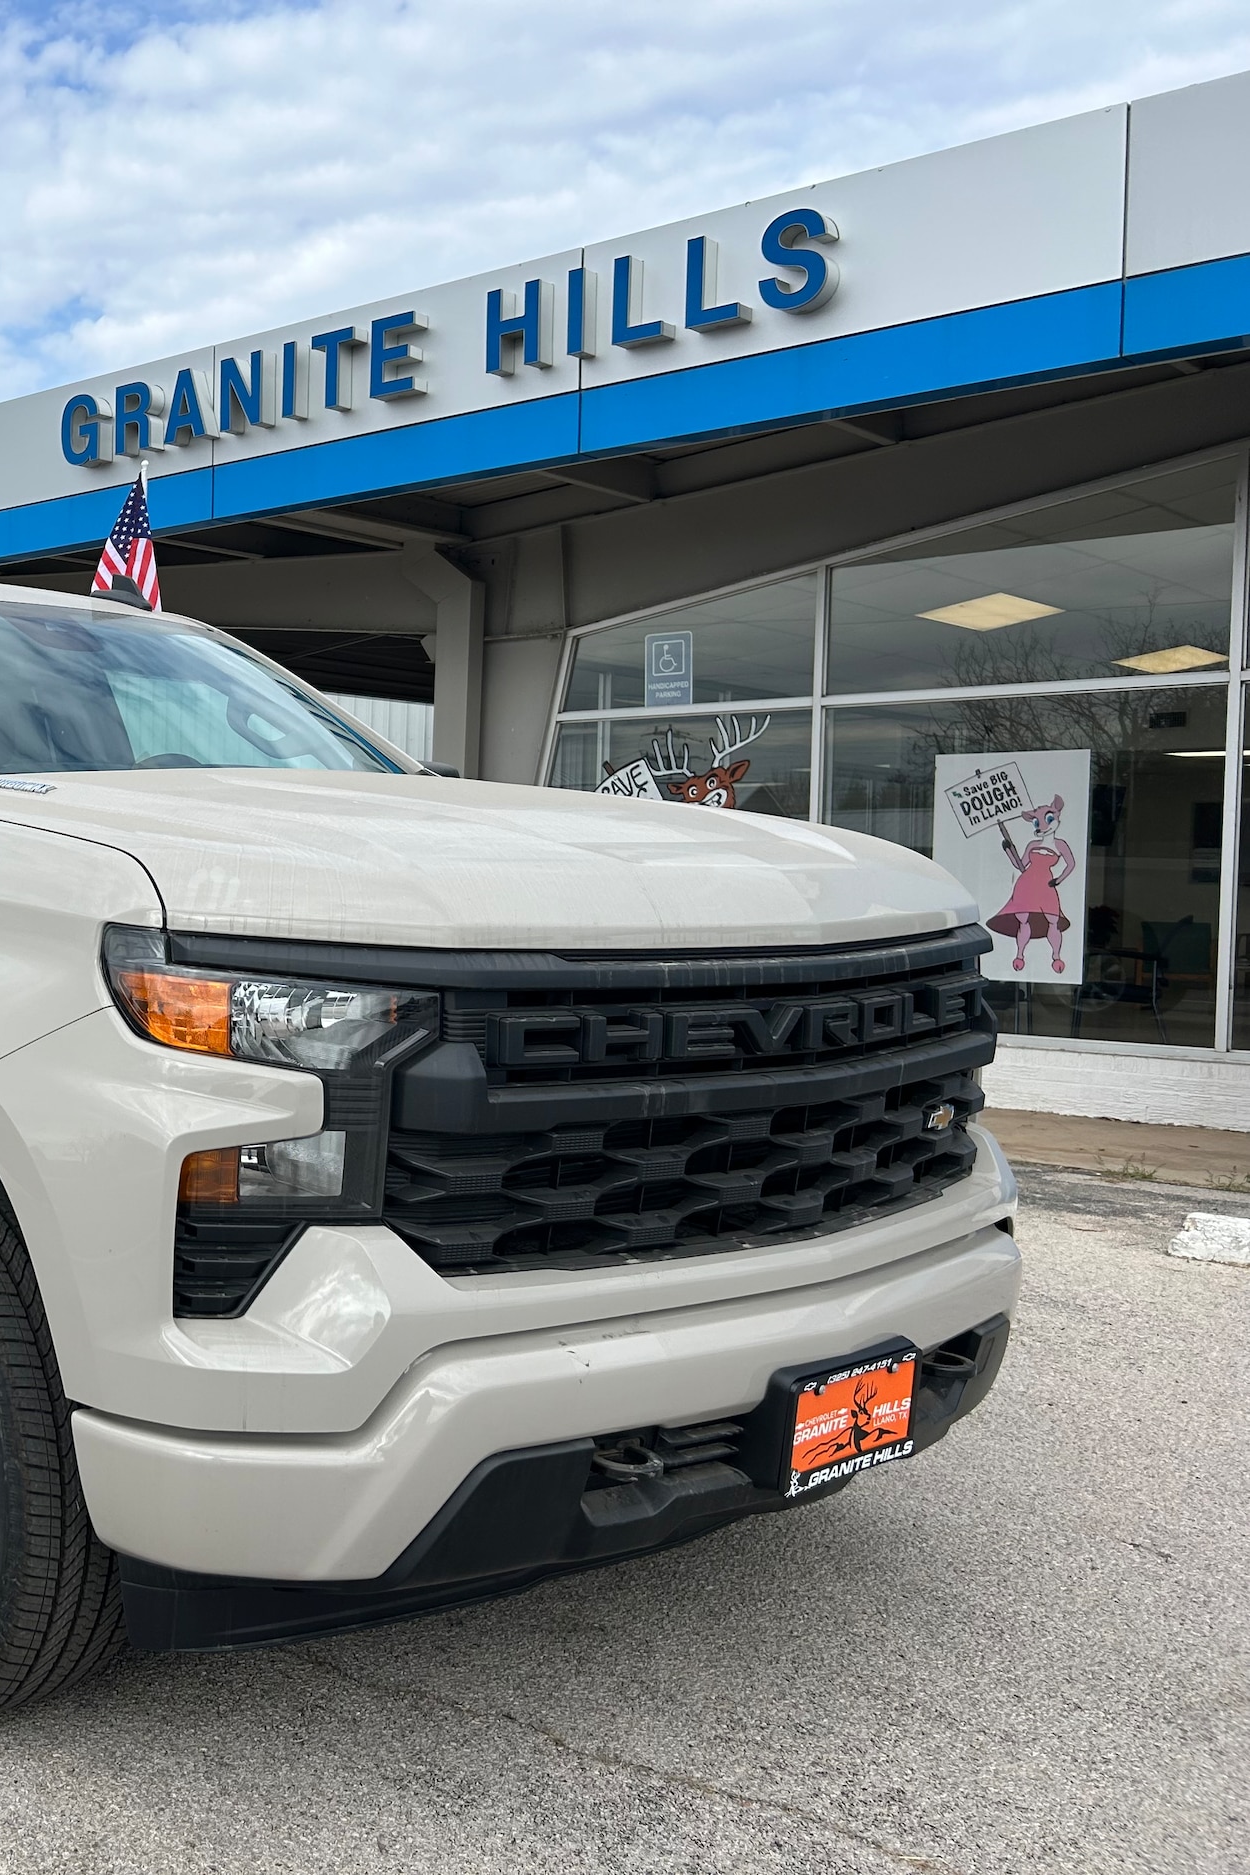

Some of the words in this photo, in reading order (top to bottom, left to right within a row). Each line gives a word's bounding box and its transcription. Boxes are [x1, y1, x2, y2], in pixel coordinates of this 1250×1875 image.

[61, 310, 429, 468] GRANITE
[486, 208, 840, 377] HILLS
[648, 681, 689, 690] HANDICAPPED
[963, 782, 989, 797] Save
[990, 771, 1008, 786] BIG
[960, 780, 1017, 816] DOUGH
[981, 796, 1022, 820] LLANO!
[486, 977, 989, 1065] CHEVROLET
[827, 1371, 850, 1384] (325)
[852, 1358, 892, 1376] 247-4151
[804, 1409, 838, 1427] CHEVROLET
[872, 1397, 911, 1418] HILLS
[873, 1414, 897, 1427] LLANO,
[898, 1412, 907, 1420] TX
[793, 1415, 848, 1446] GRANITE
[808, 1453, 872, 1488] GRANITE
[873, 1440, 914, 1464] HILLS
